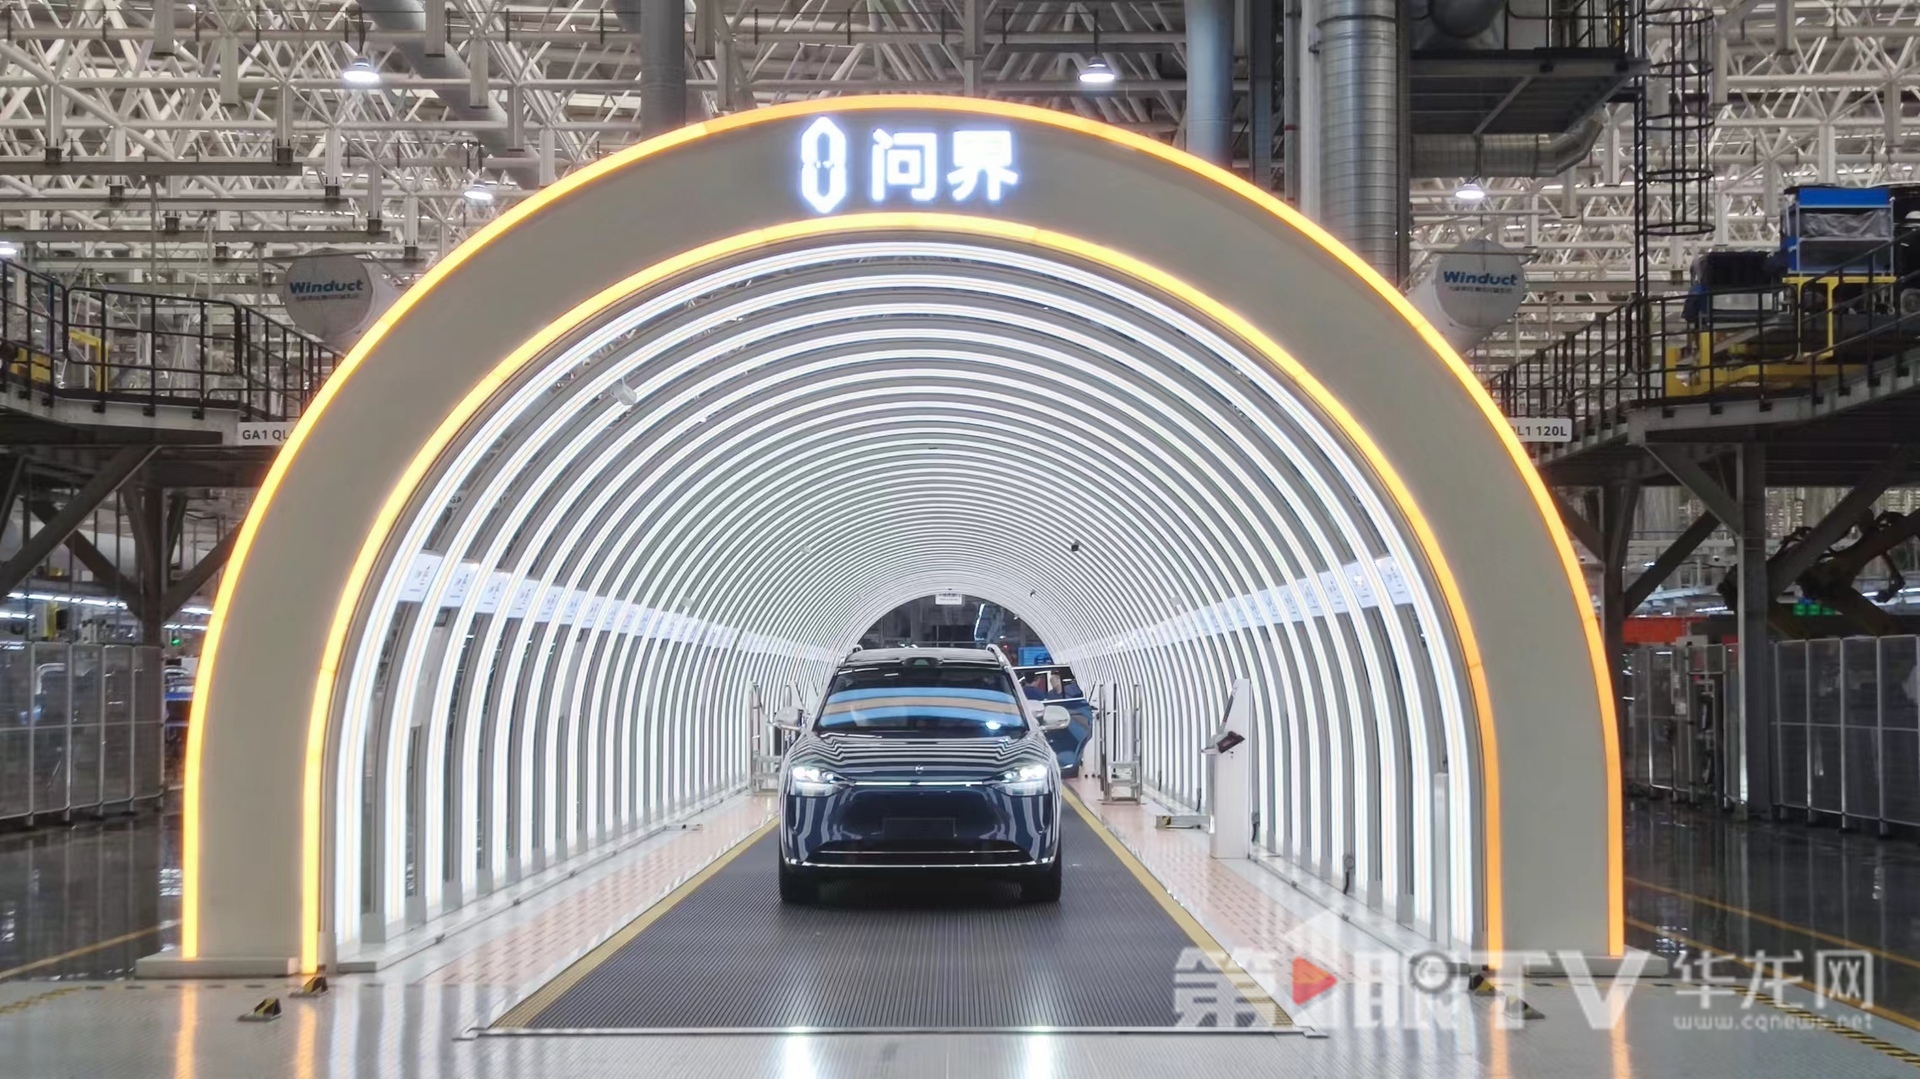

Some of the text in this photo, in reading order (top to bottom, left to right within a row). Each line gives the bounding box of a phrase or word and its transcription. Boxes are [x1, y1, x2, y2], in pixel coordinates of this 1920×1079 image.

[871, 127, 1019, 202] 问界
[1443, 270, 1518, 286] Winduct
[289, 279, 364, 294] Winduct
[242, 429, 268, 440] GA1
[1536, 425, 1568, 437] 120L
